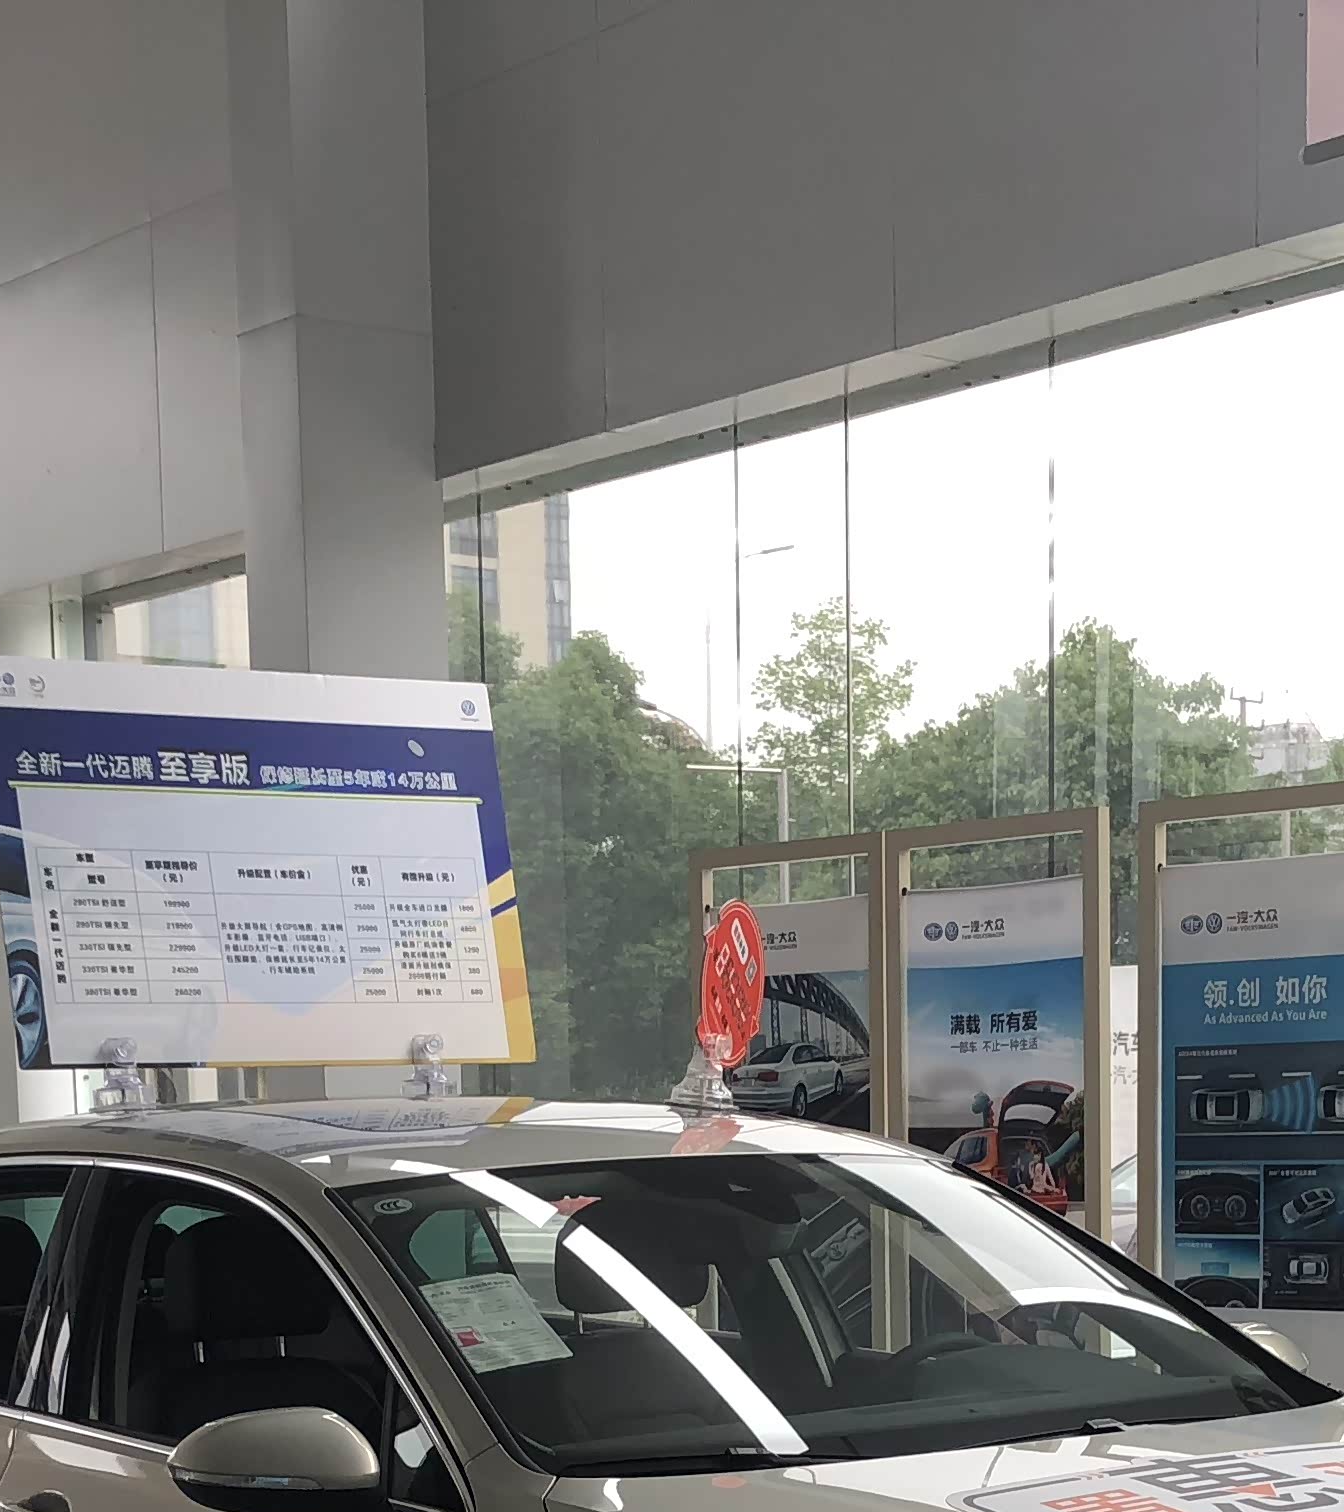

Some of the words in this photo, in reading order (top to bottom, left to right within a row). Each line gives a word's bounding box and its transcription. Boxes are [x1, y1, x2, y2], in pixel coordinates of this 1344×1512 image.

[16, 750, 154, 781] 全新一代迈腾
[158, 751, 251, 786] 至享版
[1276, 974, 1328, 1005] 如你
[950, 1014, 981, 1035] 满载
[990, 1010, 1039, 1034] 所有爱
[1204, 1014, 1217, 1025] As
[1219, 1011, 1269, 1024] Advanced
[1271, 1011, 1284, 1021] As
[1286, 1009, 1306, 1021] You
[1308, 1009, 1327, 1020] Are
[983, 1038, 1039, 1053] 不止一种生活
